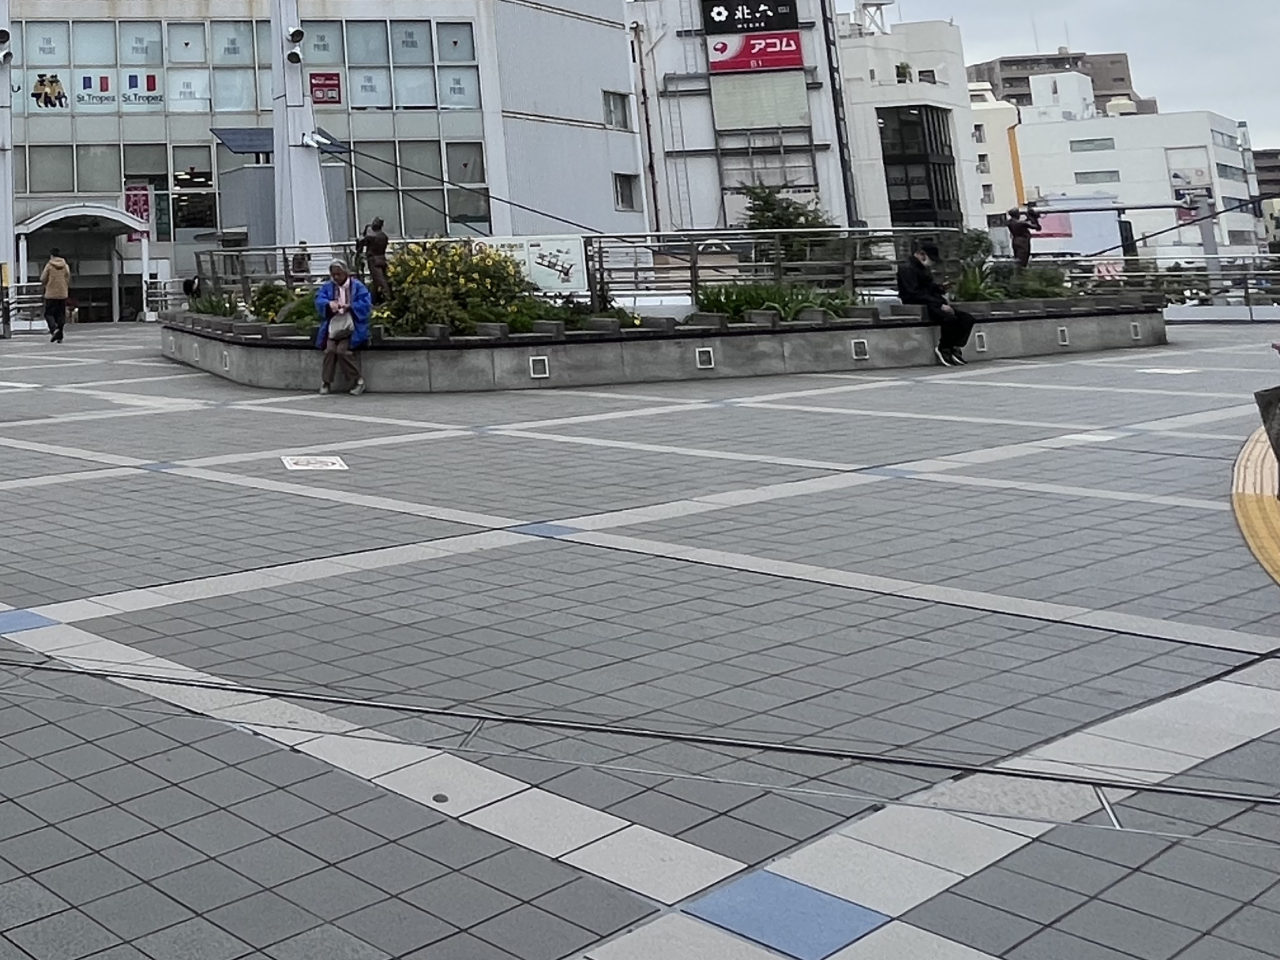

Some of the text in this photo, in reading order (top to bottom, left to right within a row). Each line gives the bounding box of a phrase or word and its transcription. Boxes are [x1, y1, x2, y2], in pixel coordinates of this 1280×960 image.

[750, 38, 797, 53] アコム
[122, 93, 164, 103] St.Tropez
